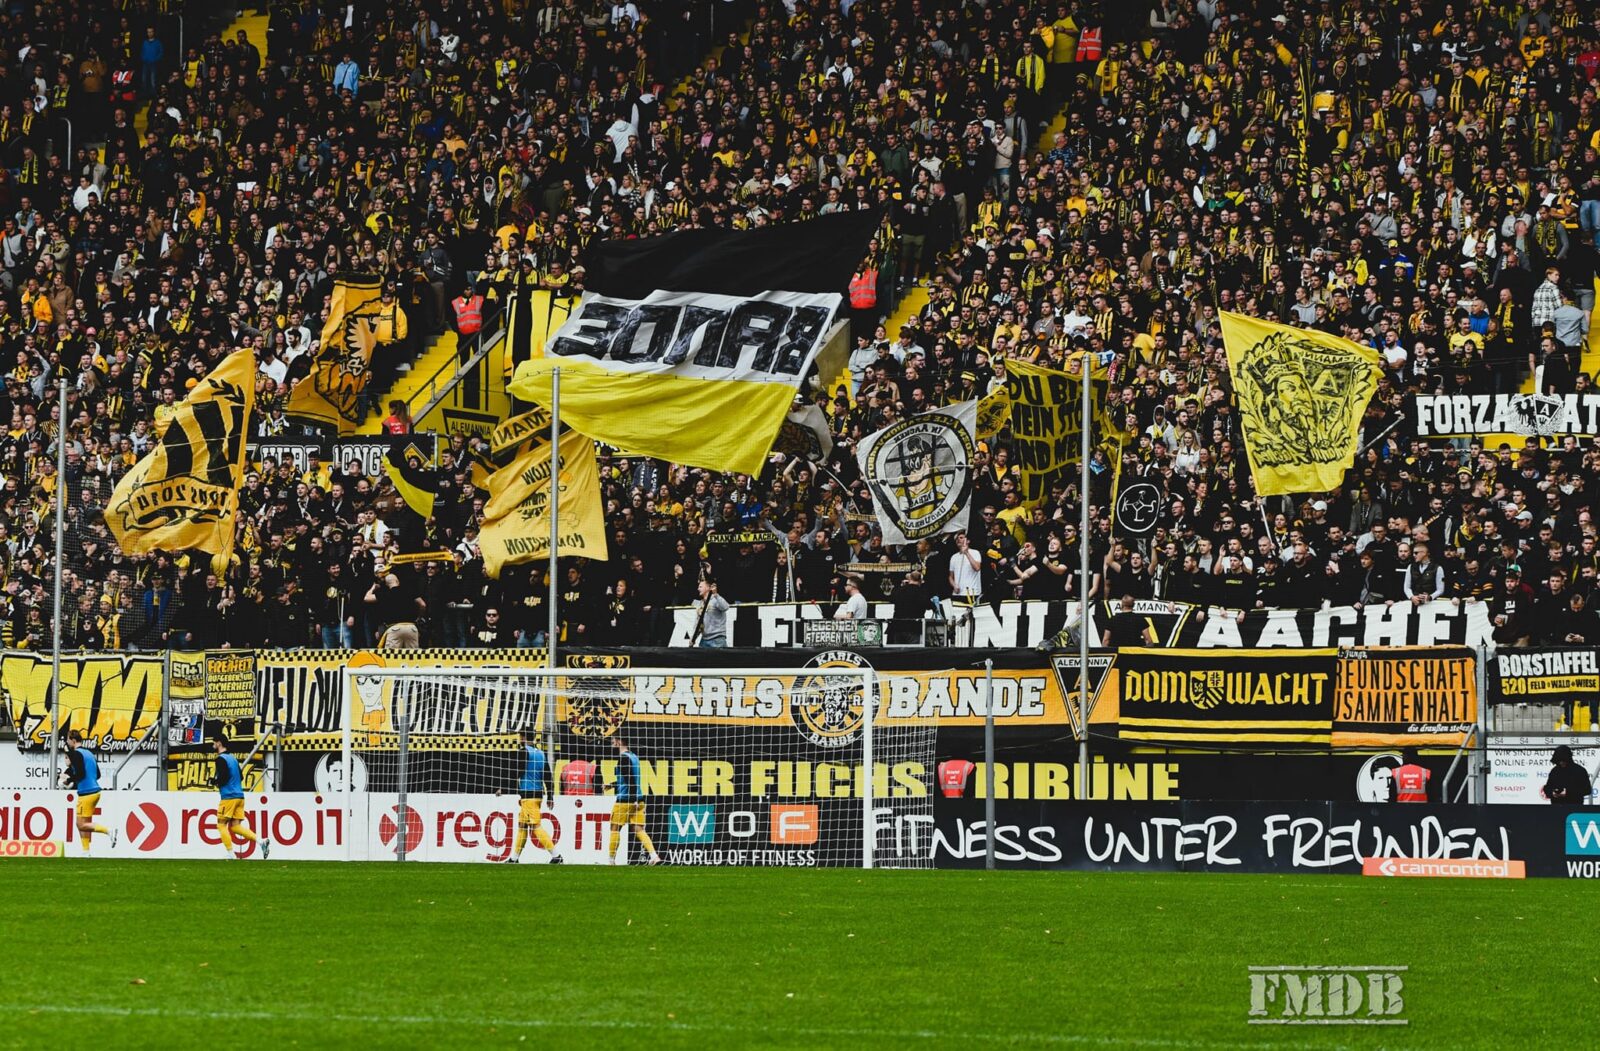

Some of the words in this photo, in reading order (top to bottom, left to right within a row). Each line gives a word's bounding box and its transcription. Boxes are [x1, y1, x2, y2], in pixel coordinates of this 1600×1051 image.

[1048, 376, 1108, 412] BIT
[1416, 393, 1512, 435] FORZA
[451, 420, 491, 435] ALEMANNIA
[806, 620, 858, 632] LEGENDEN
[805, 632, 839, 643] STERBEN
[207, 659, 253, 674] FREIHEIT
[815, 652, 862, 666] KARLS
[1057, 658, 1109, 667] ALEMNNIA
[1498, 651, 1599, 677] BOXSTAFFEL
[1125, 670, 1188, 704] DOM
[1226, 672, 1329, 706] WACHT
[1501, 677, 1527, 696] 520
[1530, 681, 1546, 690] FELD
[1551, 680, 1571, 689] WALD
[1575, 679, 1597, 689] WIESE
[256, 665, 343, 734] YELLOW
[633, 676, 784, 718] KARLS
[888, 677, 1046, 717] BANDE
[174, 702, 201, 714] NEIN
[169, 728, 184, 742] ZU
[1407, 724, 1419, 733] die
[809, 732, 856, 748] BANDE
[751, 760, 928, 798] FUCHS
[975, 754, 1180, 800] RIBÜNE
[181, 795, 303, 858] regio
[437, 808, 561, 862] rego
[575, 799, 612, 850] iT
[871, 807, 1063, 862] FITNESS
[1084, 815, 1242, 865] UNTER
[1262, 813, 1510, 868] FREUNDEN
[669, 850, 722, 866] WORLD
[727, 850, 748, 865] OF
[752, 849, 816, 867] FITNESS
[1400, 861, 1509, 877] camcontrol
